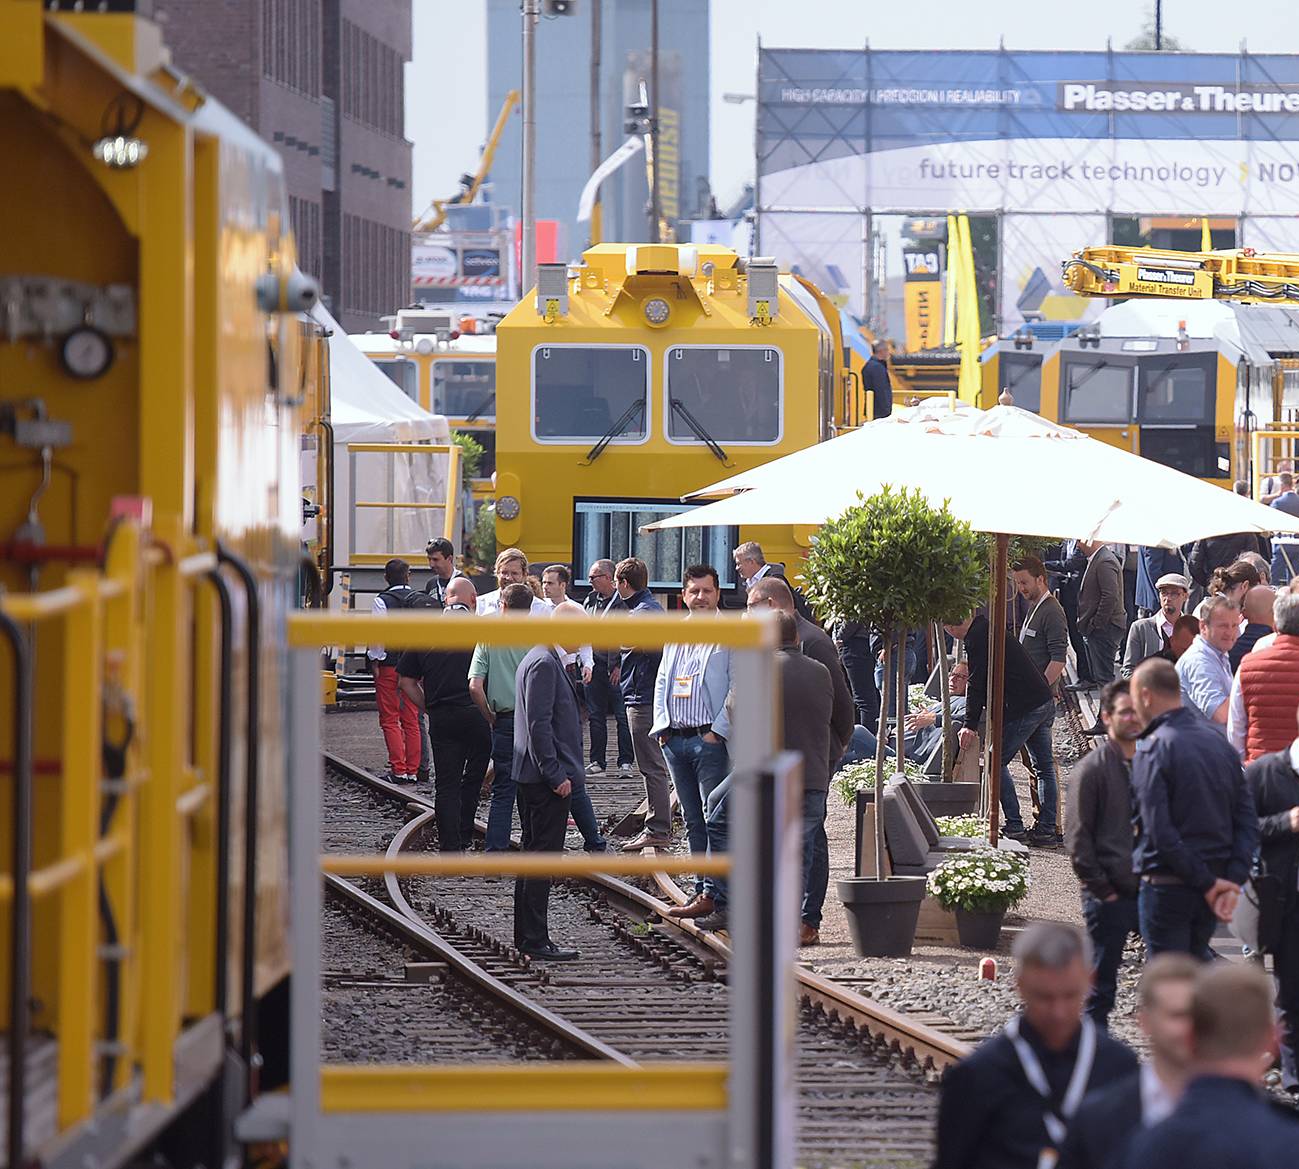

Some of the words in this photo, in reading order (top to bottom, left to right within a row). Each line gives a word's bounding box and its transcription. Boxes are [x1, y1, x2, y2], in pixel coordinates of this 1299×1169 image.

[782, 88, 810, 103] HIGH
[811, 88, 868, 104] CAPACITY
[876, 88, 938, 104] PRECISION
[919, 158, 1000, 179] future
[1007, 160, 1074, 180] track
[1081, 161, 1227, 187] technology
[1129, 282, 1156, 293] Material
[1158, 284, 1187, 296] Transfer
[1188, 287, 1202, 297] Unit
